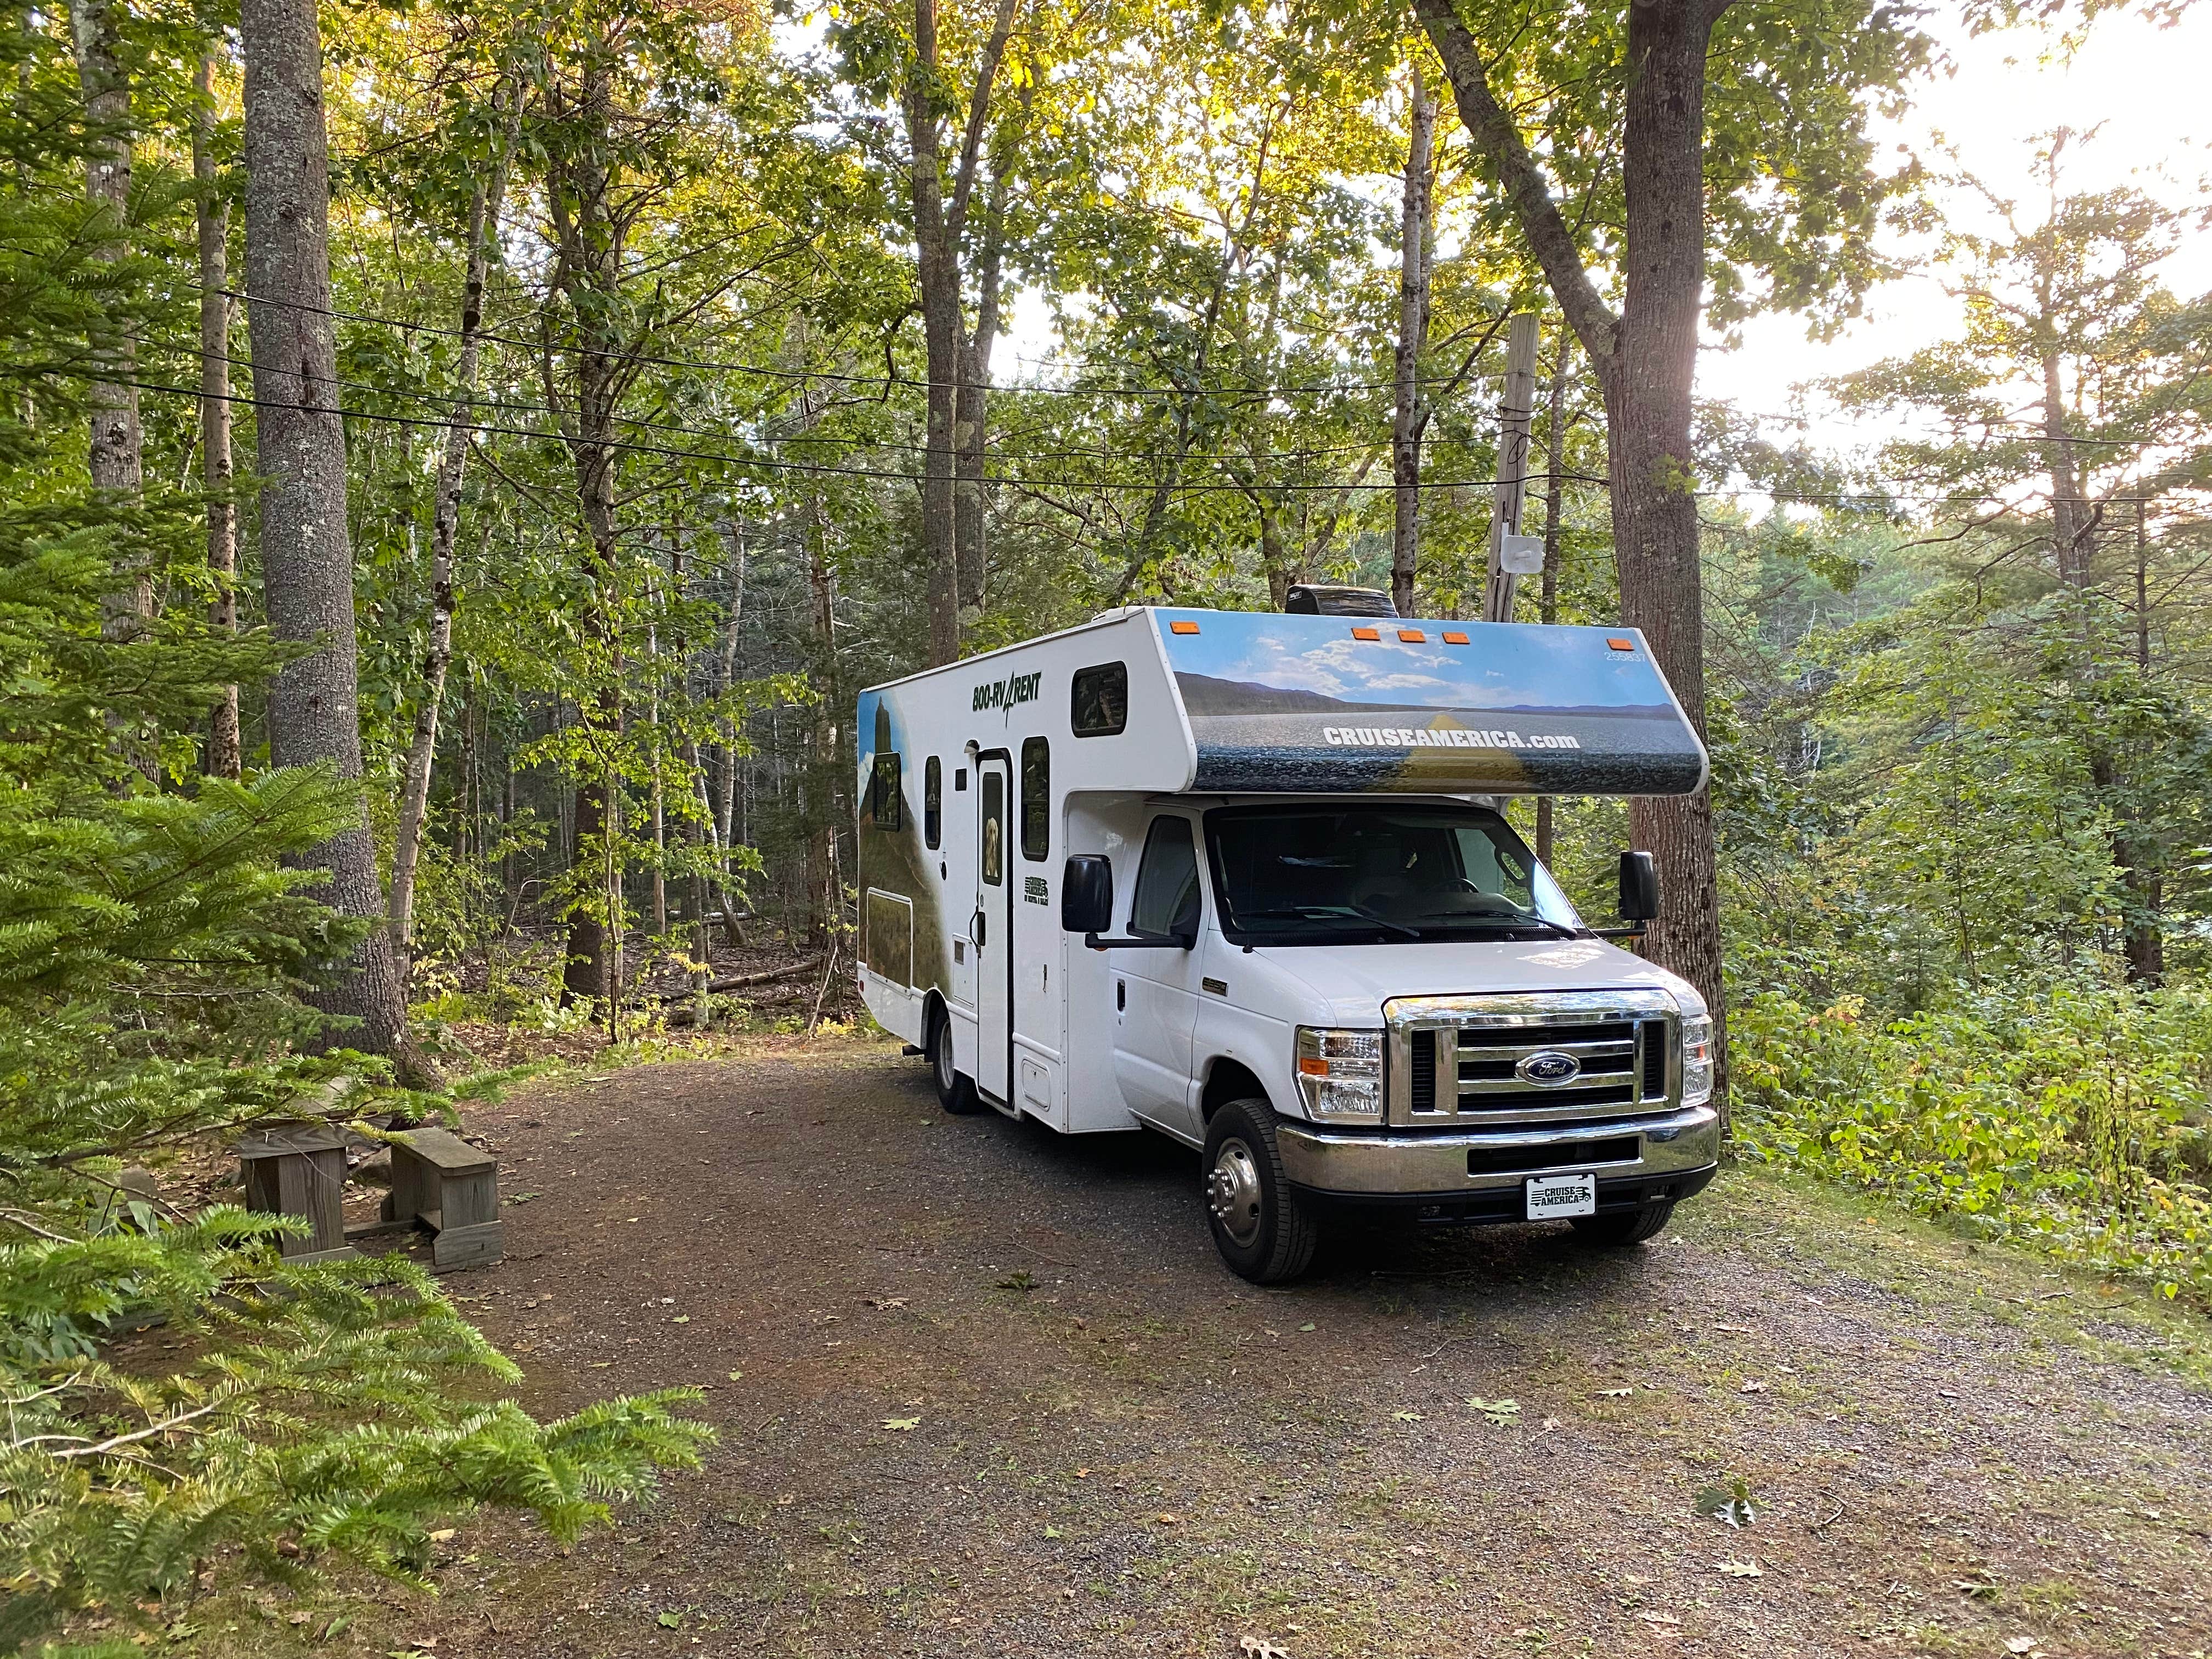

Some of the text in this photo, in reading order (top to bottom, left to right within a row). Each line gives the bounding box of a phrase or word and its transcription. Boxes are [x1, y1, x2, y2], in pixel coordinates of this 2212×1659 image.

[1604, 652, 1646, 662] 255837
[1323, 727, 1581, 749] CRUISEAMERICA.com
[1538, 1061, 1566, 1075] Ford
[1544, 1186, 1576, 1197] CRUISE
[1541, 1195, 1579, 1206] AMERICA
